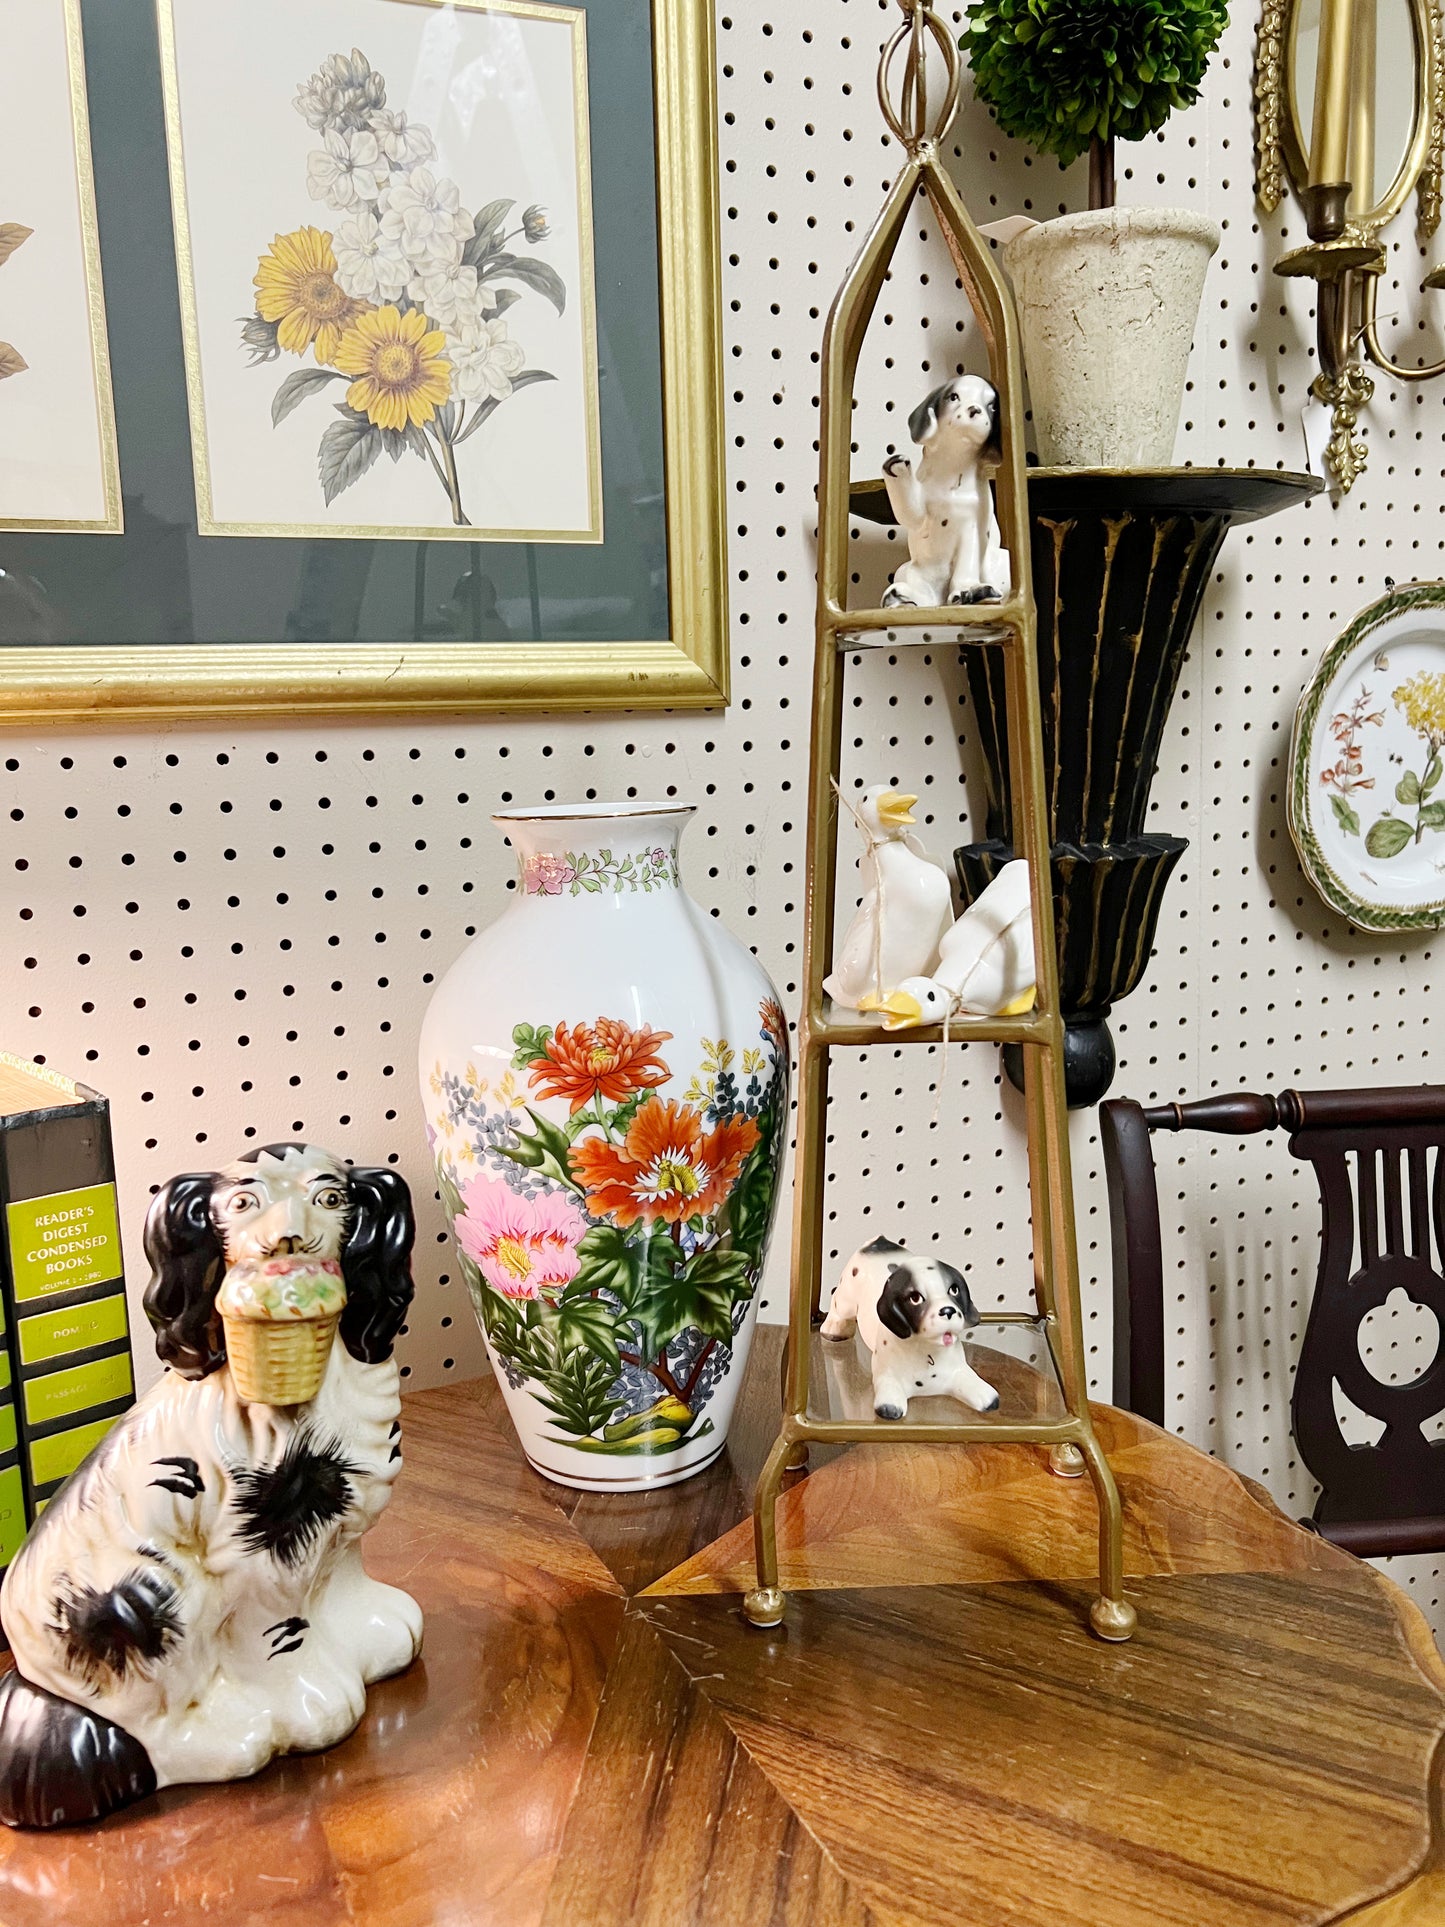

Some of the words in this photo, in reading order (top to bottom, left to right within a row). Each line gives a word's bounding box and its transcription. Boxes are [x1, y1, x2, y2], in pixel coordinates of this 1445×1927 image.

[35, 1206, 95, 1228] READER'S
[42, 1223, 89, 1242] DIGEST
[26, 1235, 108, 1262] CONDENSED
[45, 1255, 93, 1275] BOOKS
[40, 1278, 70, 1291] VOLUME
